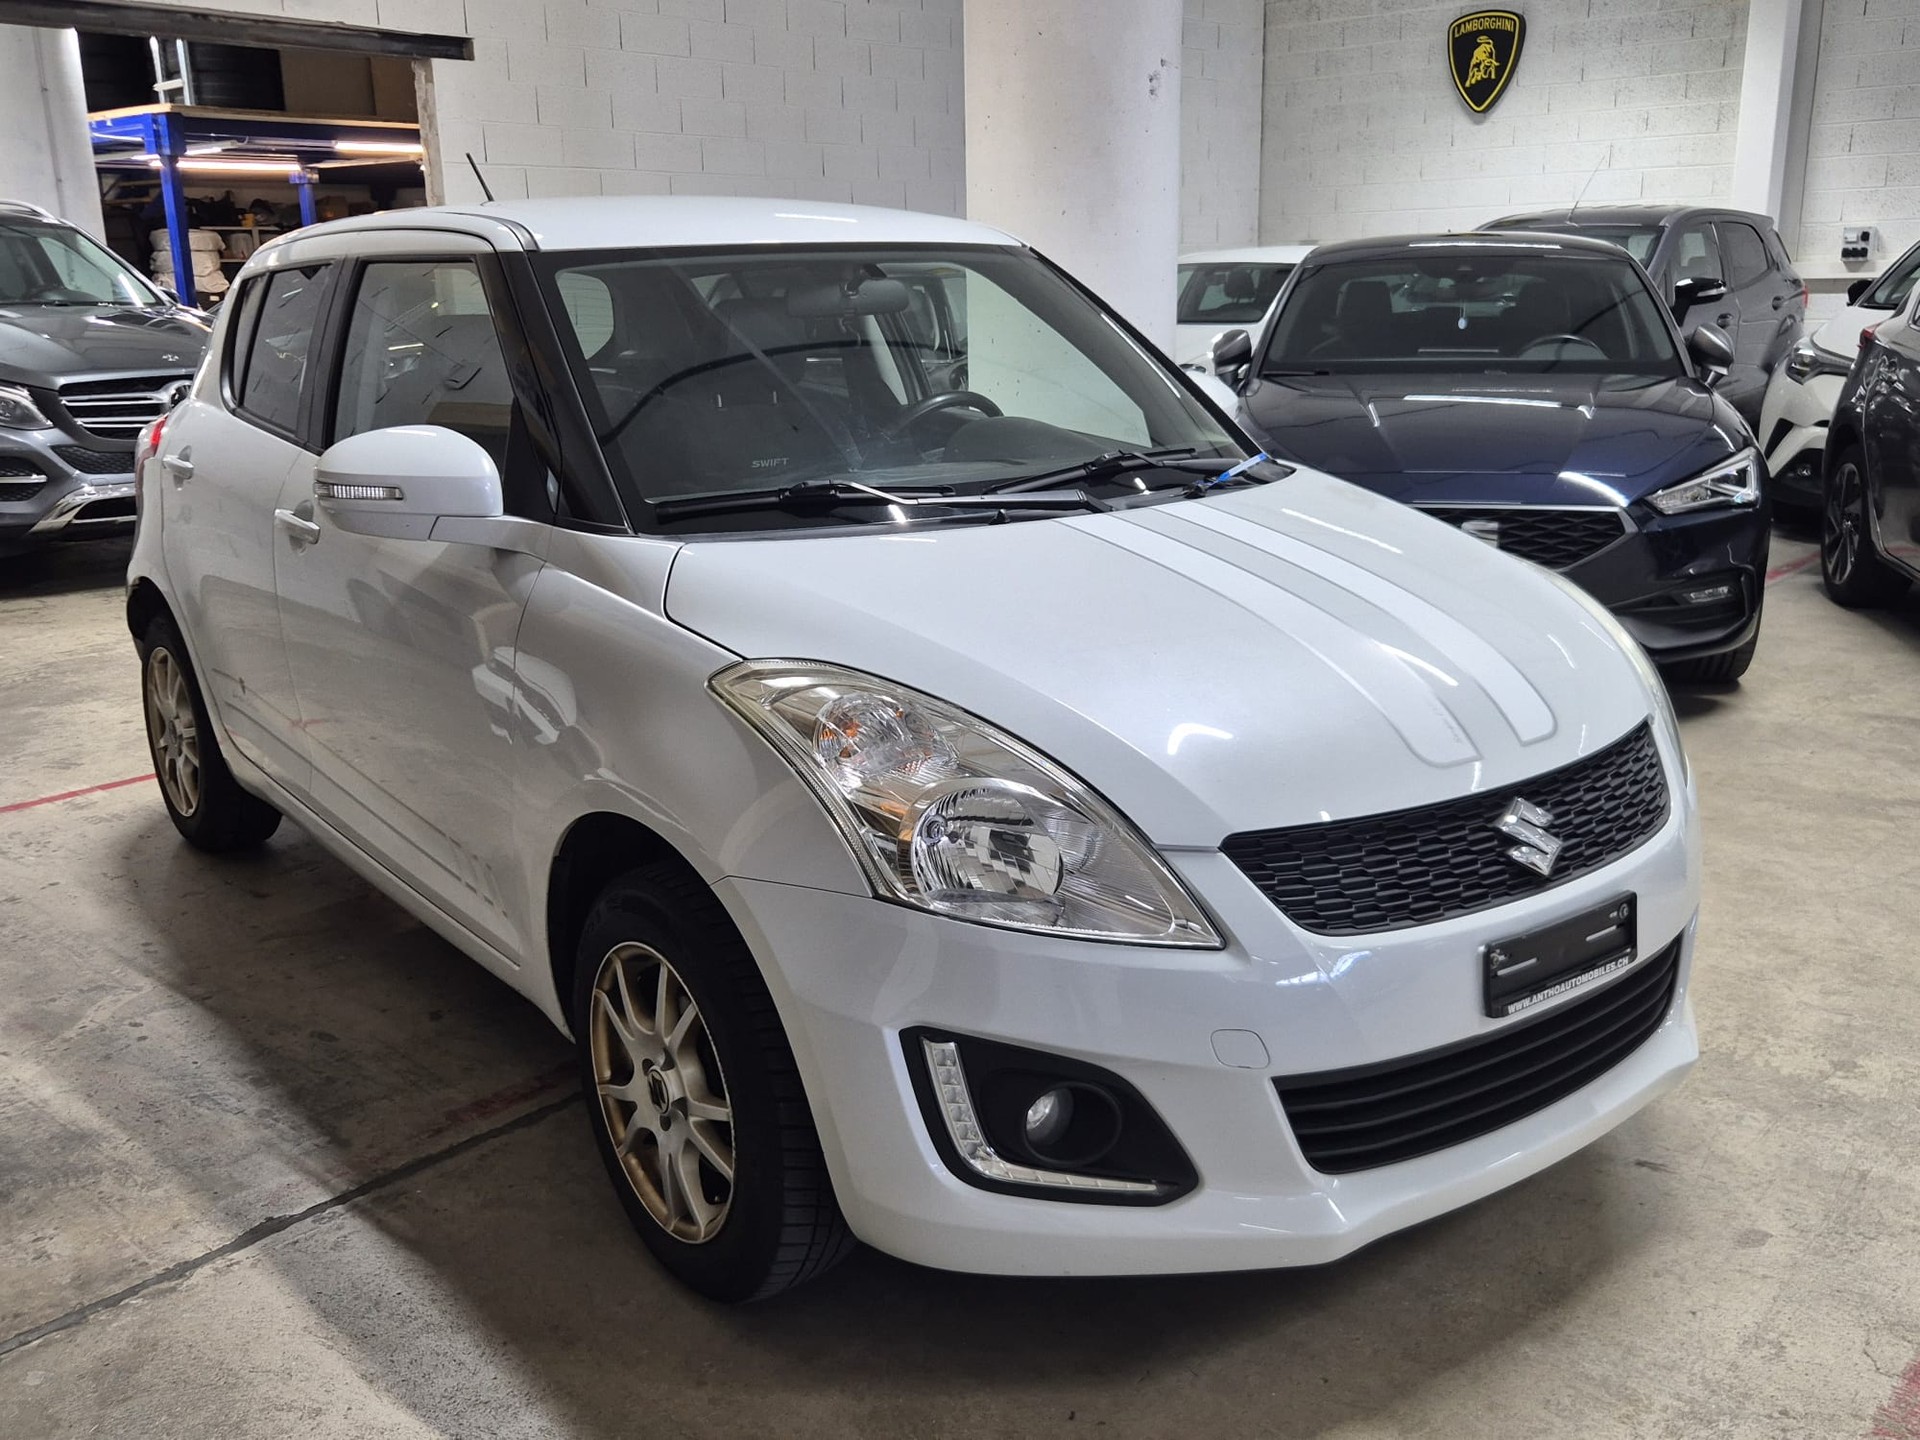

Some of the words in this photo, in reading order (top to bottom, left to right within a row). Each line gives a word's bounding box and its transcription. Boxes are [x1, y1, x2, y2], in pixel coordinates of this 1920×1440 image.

[1454, 17, 1514, 38] LAMBORGHINI
[751, 457, 790, 468] SWIFT
[1507, 956, 1629, 1015] WWW.ANTHOAUTOMOBILES.CH
